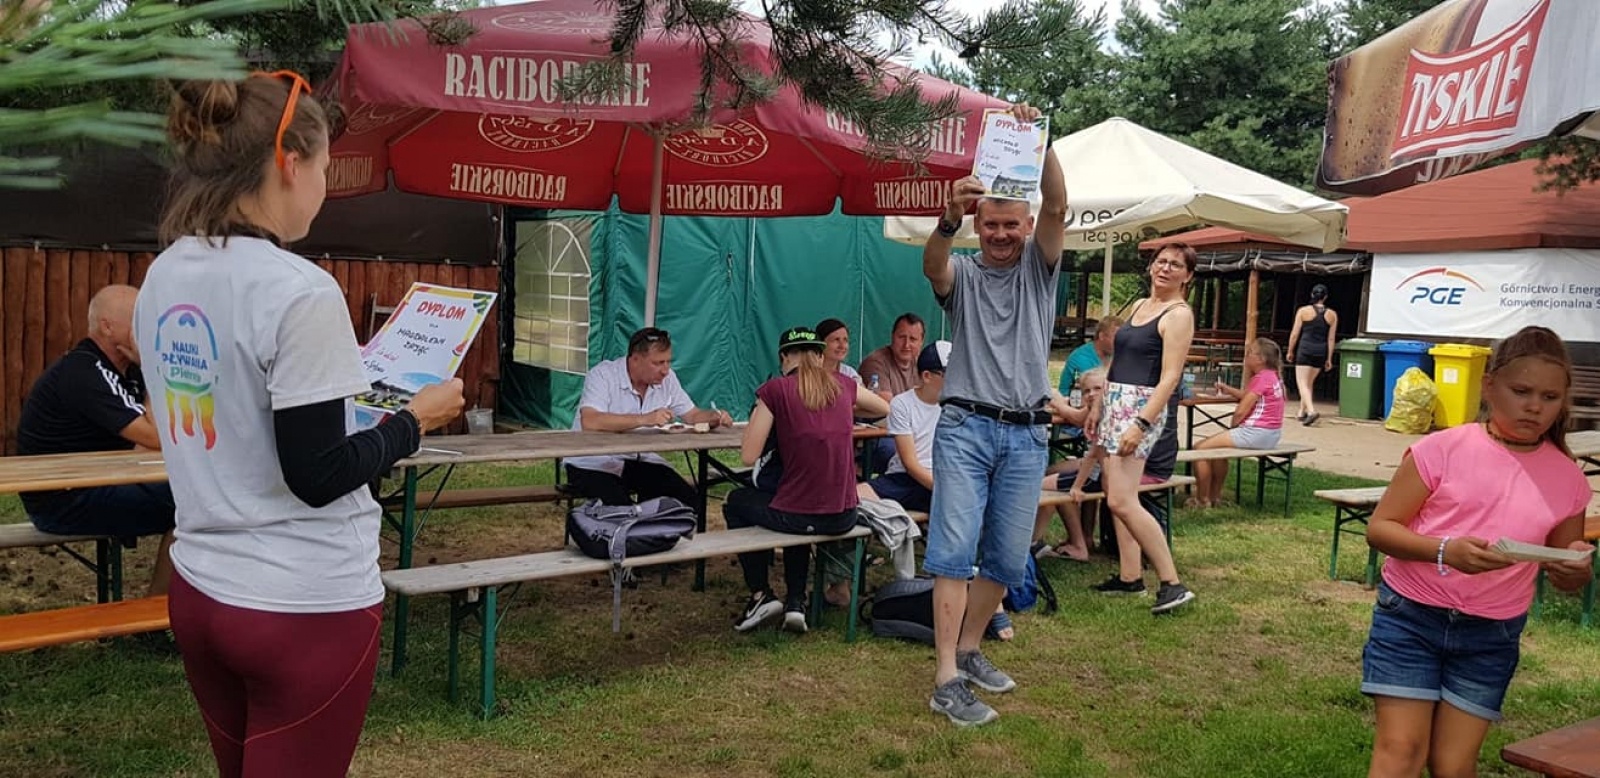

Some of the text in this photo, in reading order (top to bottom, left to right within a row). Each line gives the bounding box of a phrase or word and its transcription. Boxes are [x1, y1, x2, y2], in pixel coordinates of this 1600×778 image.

[1401, 31, 1529, 140] TYSKIE
[996, 118, 1032, 133] DYPLOM
[1410, 287, 1466, 305] PGE
[1500, 283, 1559, 294] Górnictwo
[1561, 282, 1566, 294] i
[416, 300, 467, 321] DYPLOM
[1500, 297, 1593, 310] Konwencjonalna
